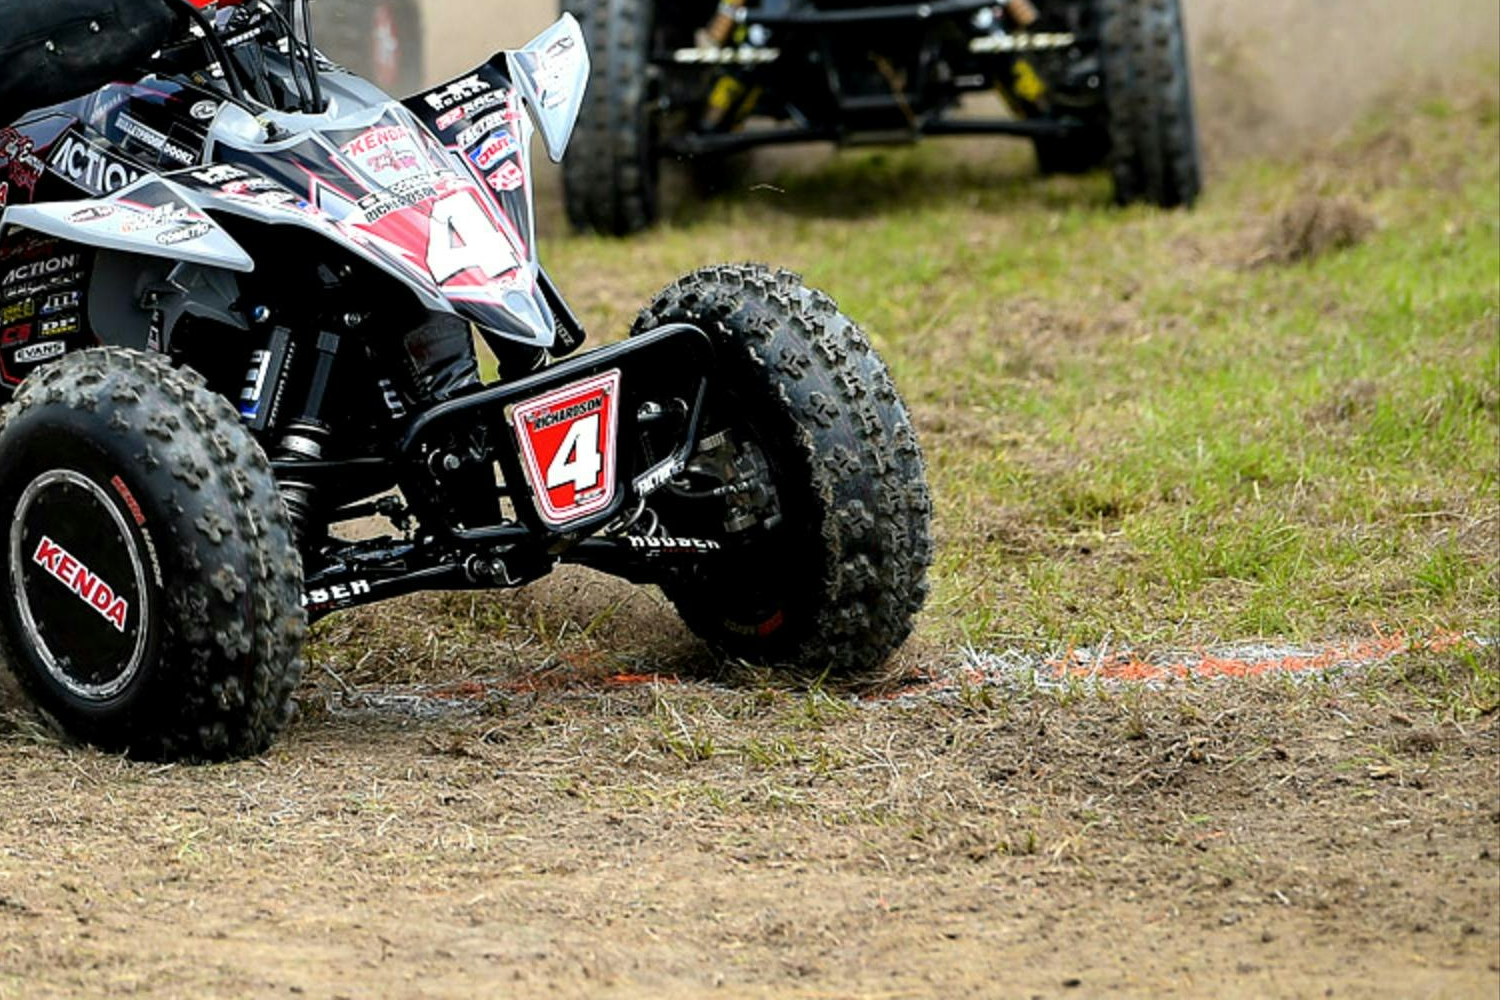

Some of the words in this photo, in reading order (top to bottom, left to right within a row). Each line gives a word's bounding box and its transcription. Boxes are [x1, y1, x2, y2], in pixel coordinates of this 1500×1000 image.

[51, 136, 145, 194] ACTIO
[350, 127, 410, 157] KENDA
[425, 191, 522, 287] 4
[2, 253, 75, 287] ACTION
[533, 397, 603, 431] RICHARDSON
[546, 413, 602, 492] 4
[33, 535, 129, 632] KENDA
